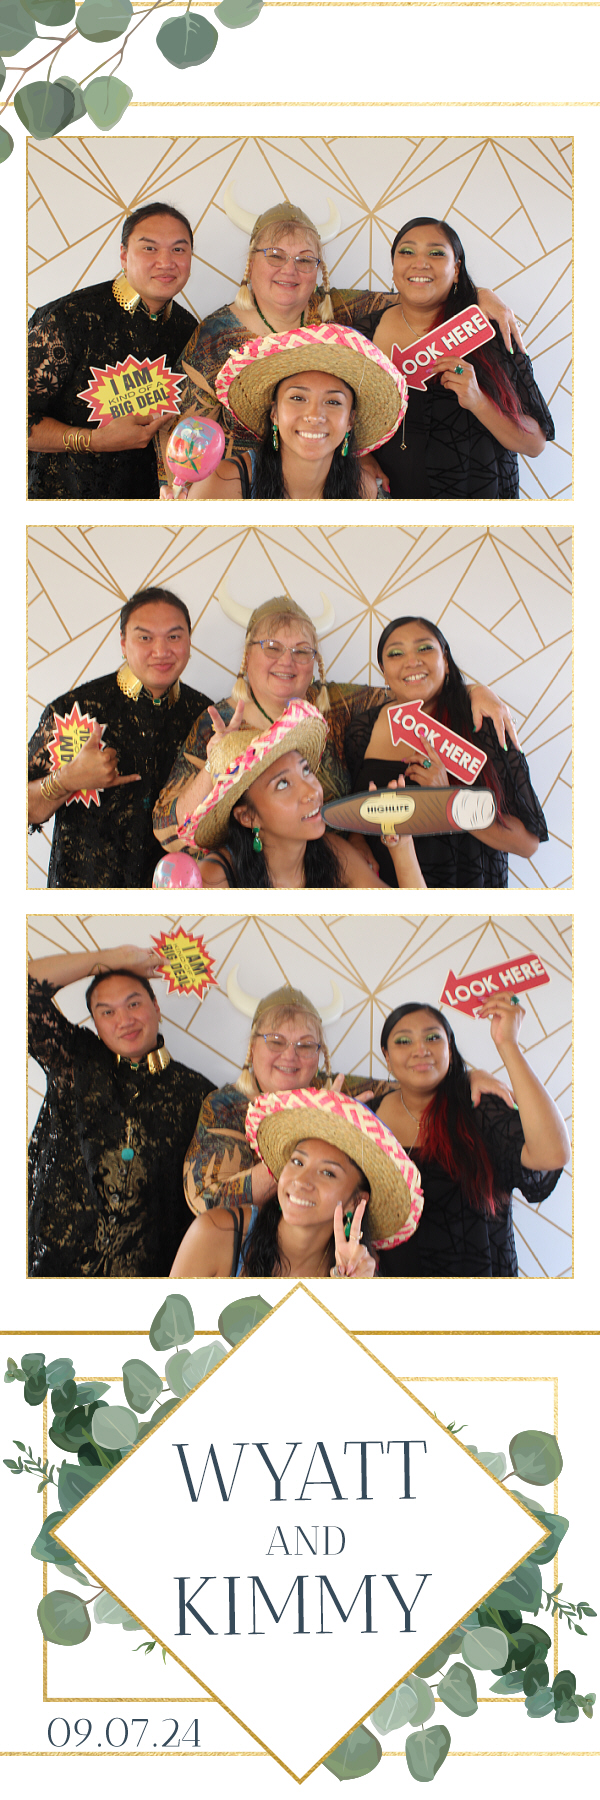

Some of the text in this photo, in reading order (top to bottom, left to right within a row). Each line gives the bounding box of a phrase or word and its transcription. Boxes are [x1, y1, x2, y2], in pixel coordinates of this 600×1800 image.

[402, 312, 488, 378] OOK HERE
[108, 391, 136, 406] KIND
[138, 383, 153, 394] OF
[109, 366, 153, 396] I AM
[109, 387, 170, 419] BIG DEAL
[392, 707, 482, 775] LOOK HERE
[367, 804, 410, 814] HIGHLIFE
[161, 943, 190, 988] BIG DEAL
[185, 953, 208, 976] AM
[444, 958, 545, 1006] LOOK HERE
